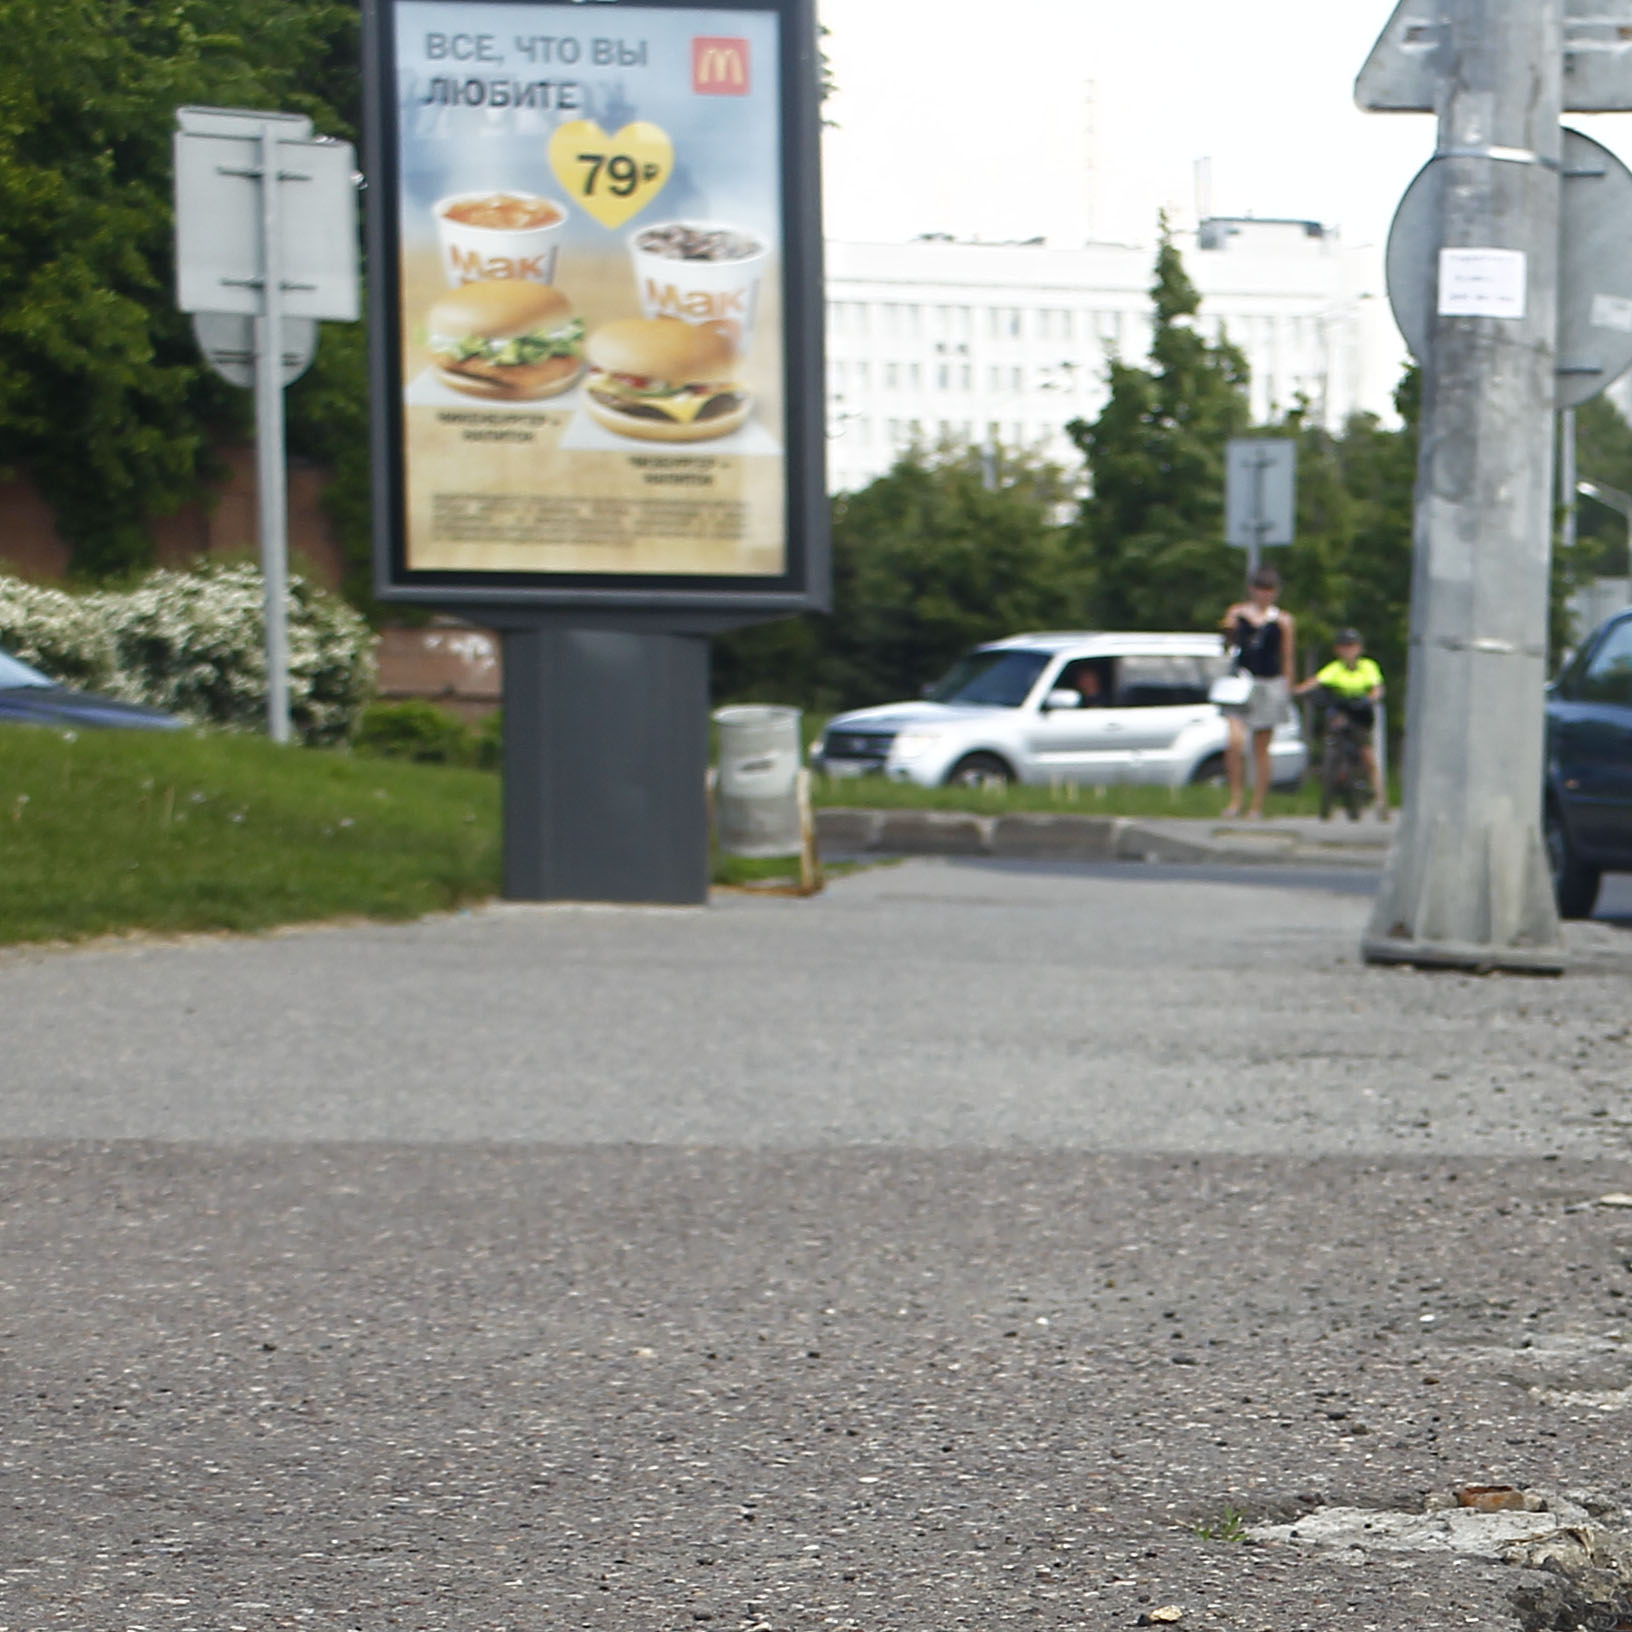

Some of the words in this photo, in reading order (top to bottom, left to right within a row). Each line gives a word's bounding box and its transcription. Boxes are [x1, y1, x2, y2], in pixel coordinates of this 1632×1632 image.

[425, 32, 503, 67] ВСЕ,
[515, 36, 581, 65] ЧТО
[591, 38, 648, 67] ВЫ
[424, 77, 579, 110] ЛЮБИТЕ
